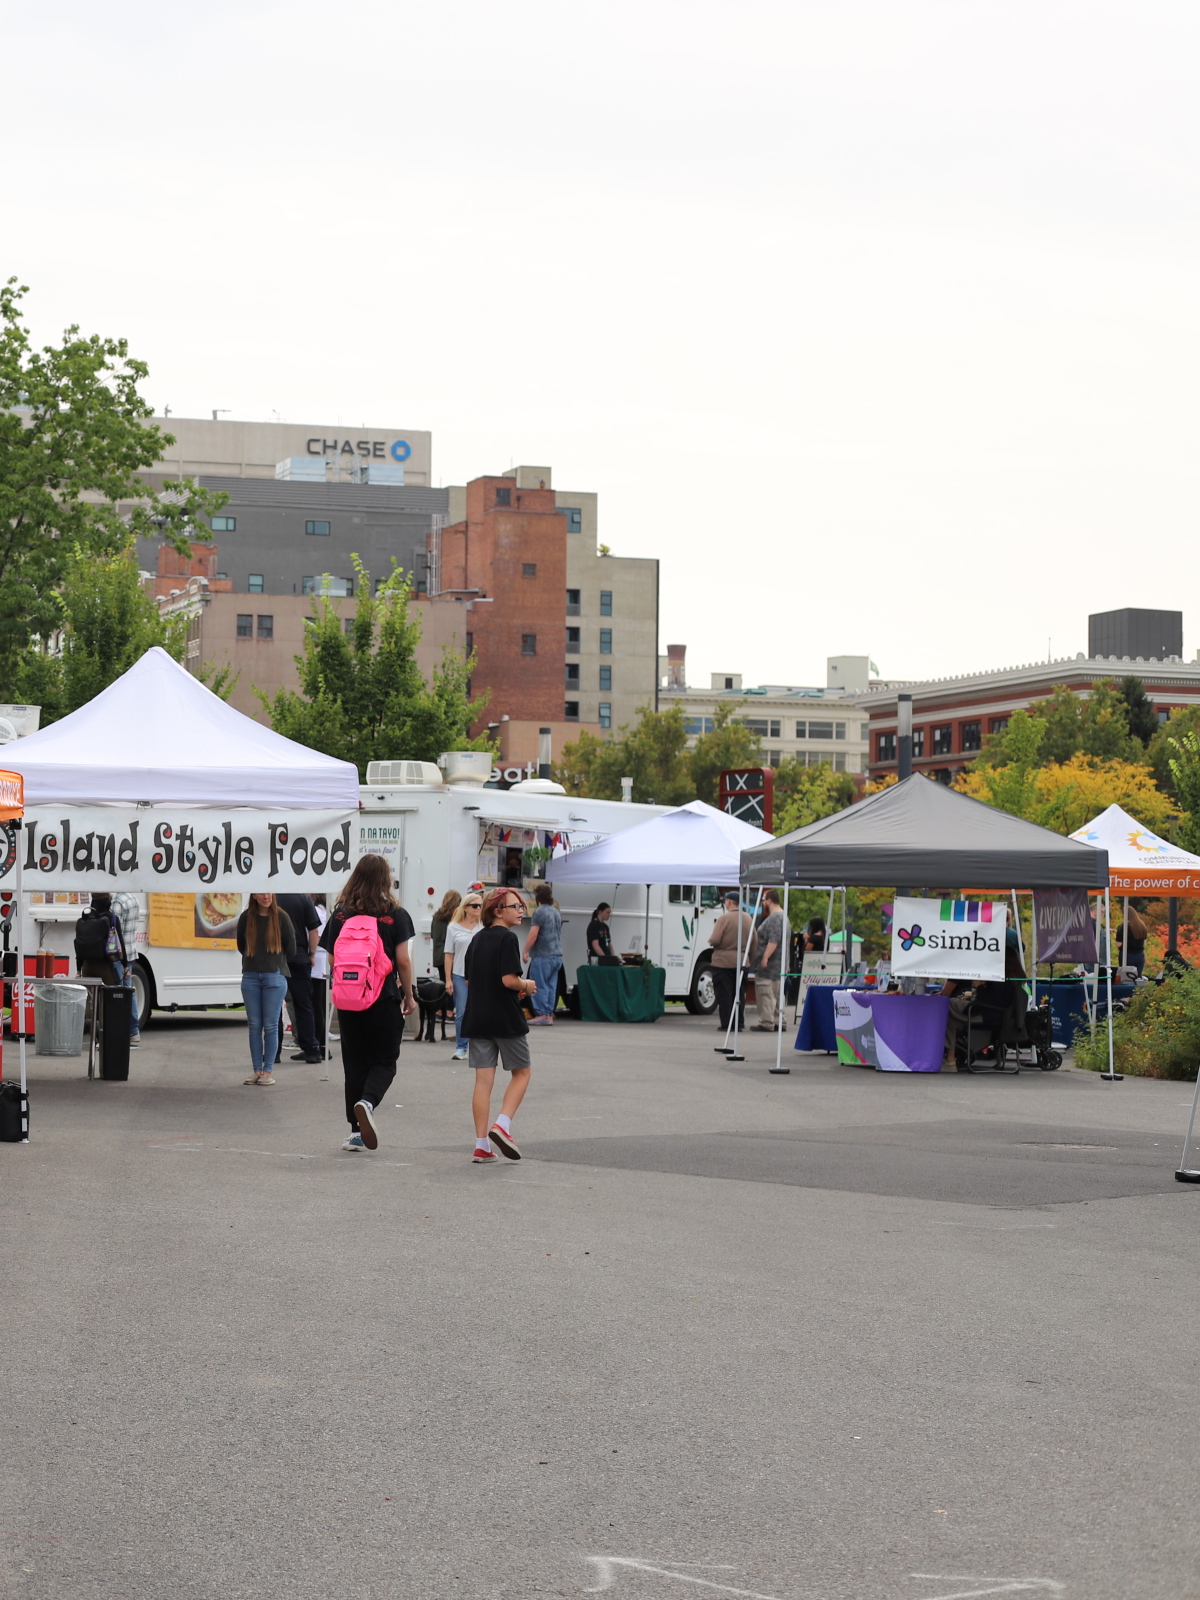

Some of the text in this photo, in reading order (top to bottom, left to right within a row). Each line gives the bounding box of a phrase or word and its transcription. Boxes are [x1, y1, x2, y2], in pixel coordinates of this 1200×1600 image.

[307, 438, 386, 458] CHASE
[23, 819, 353, 884] Island Style Food
[1109, 875, 1131, 888] The
[1134, 878, 1175, 891] power
[1177, 876, 1191, 888] of
[928, 930, 1000, 952] simba
